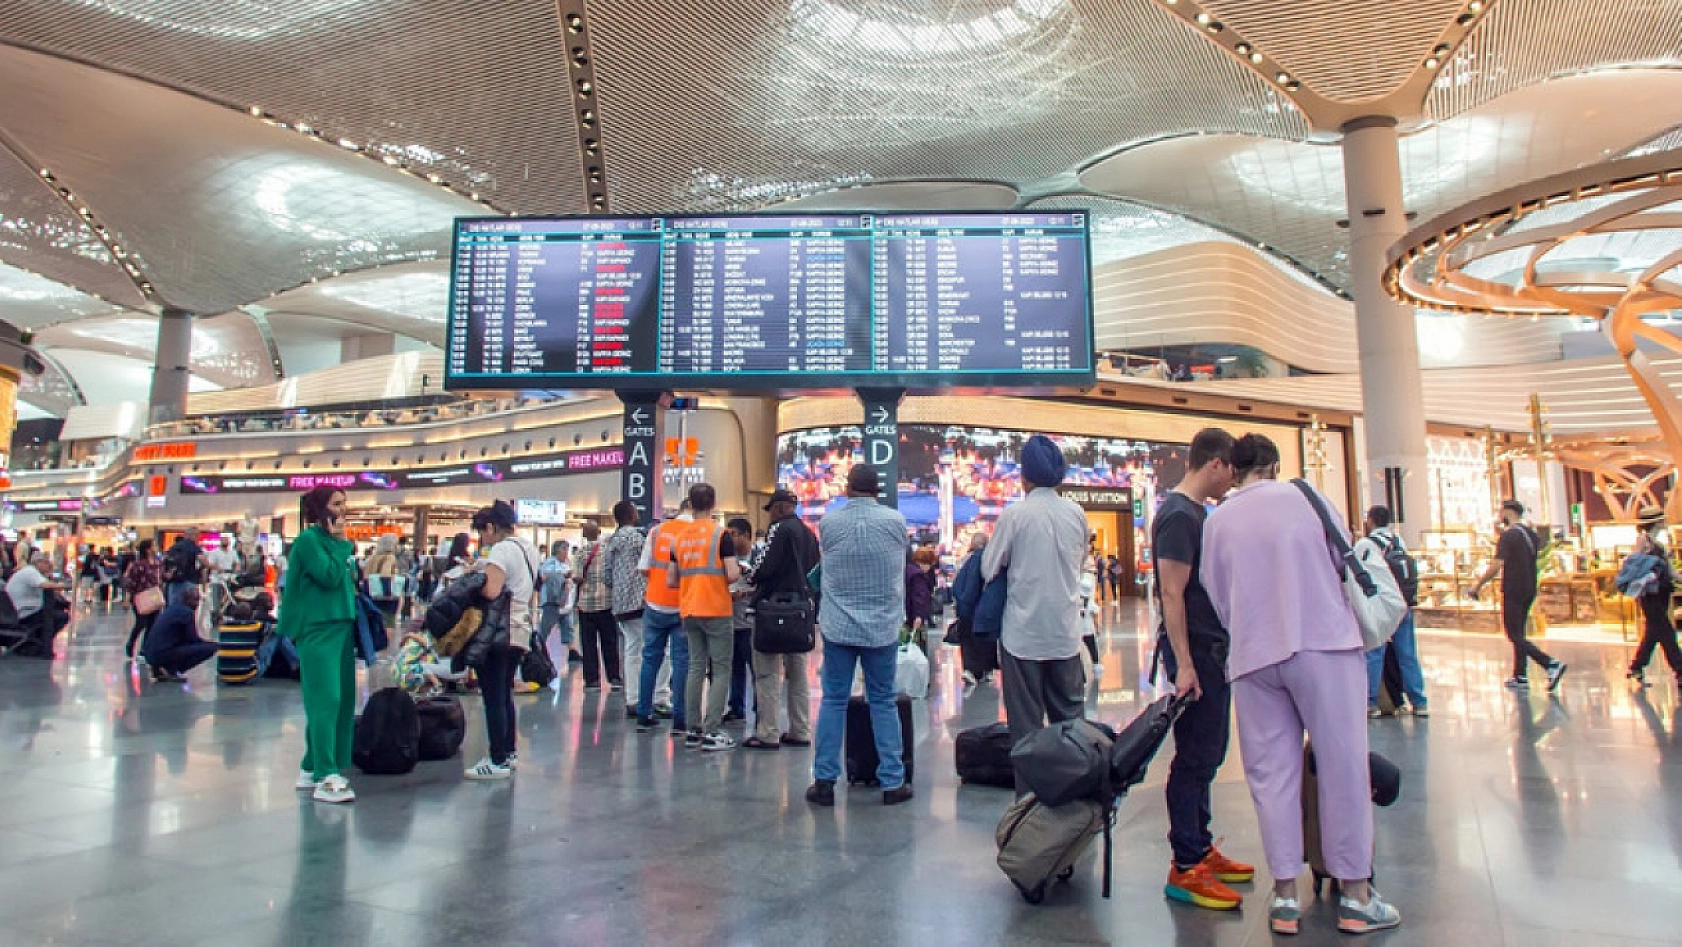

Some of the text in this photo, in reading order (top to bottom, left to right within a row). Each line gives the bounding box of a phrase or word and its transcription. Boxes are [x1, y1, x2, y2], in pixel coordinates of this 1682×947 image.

[624, 427, 656, 437] GATES
[865, 424, 897, 434] GATES
[628, 441, 649, 466] A
[872, 440, 893, 465] D
[568, 455, 591, 469] FREE
[289, 476, 314, 488] FREE
[315, 474, 356, 487] MAKEUP
[628, 473, 646, 498] B
[1090, 490, 1128, 503] VUITTON
